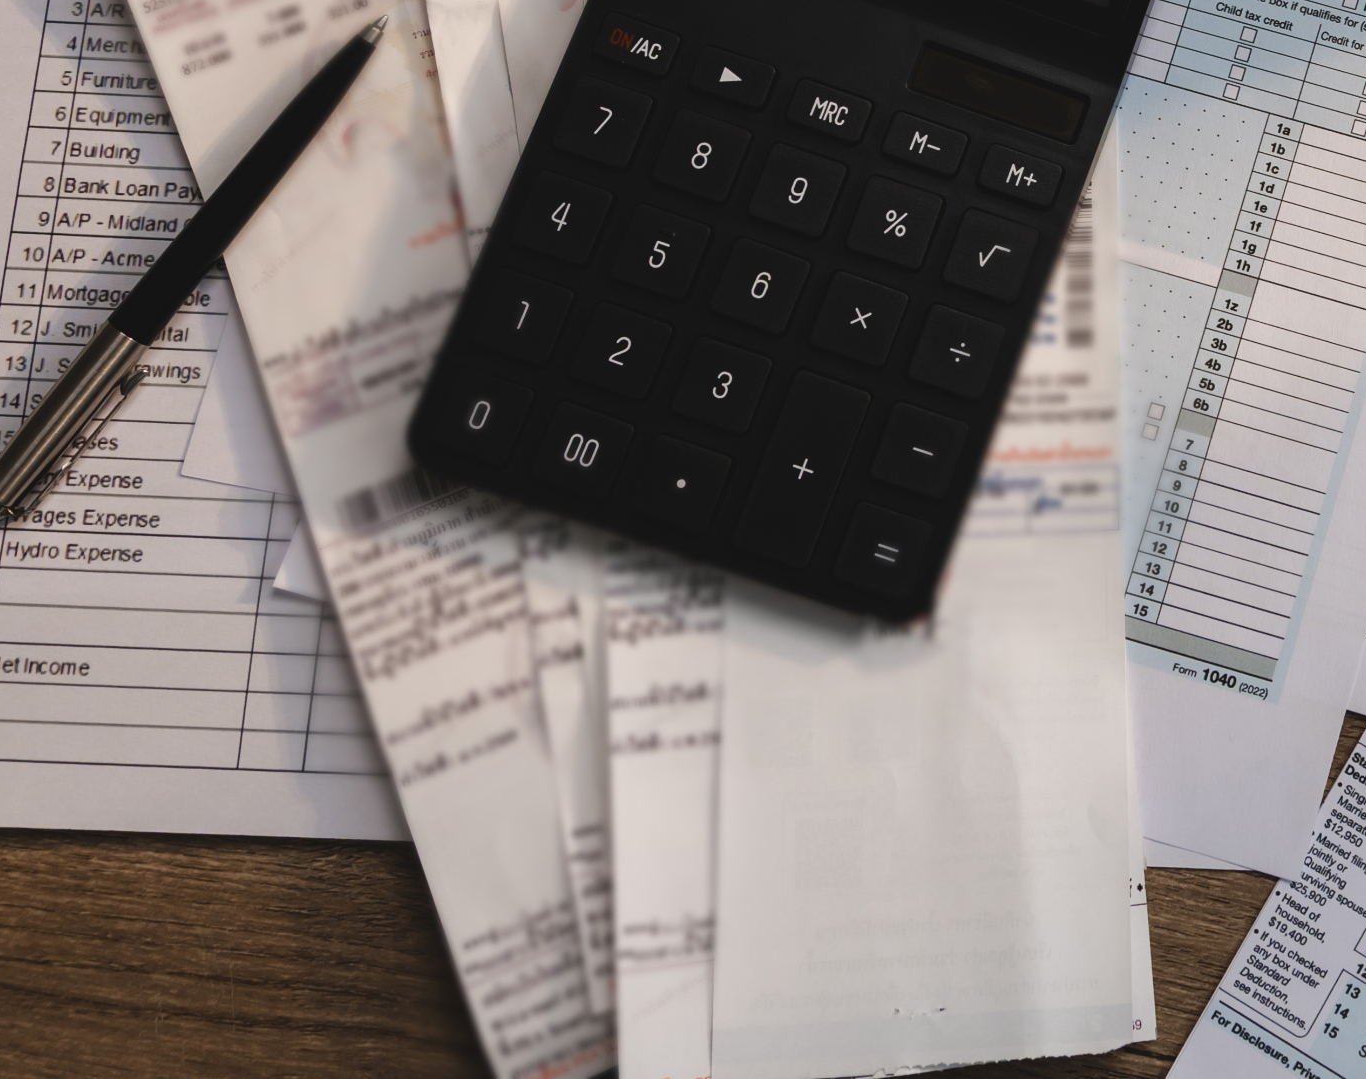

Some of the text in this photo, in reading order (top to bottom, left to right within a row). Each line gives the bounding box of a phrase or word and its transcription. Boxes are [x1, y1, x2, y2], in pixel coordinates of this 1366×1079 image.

[1215, 1, 1294, 32] Child tax credit
[610, 28, 662, 60] ON/AC
[61, 70, 73, 86] 5
[81, 70, 157, 92] Furniture
[593, 106, 613, 135] 7
[809, 96, 849, 126] MRC
[1277, 123, 1291, 136] 1a
[51, 140, 62, 156] 7
[69, 141, 141, 165] Building
[691, 141, 713, 170] 8
[1005, 163, 1038, 187] M+
[788, 177, 808, 204] 9
[551, 202, 571, 232] 4
[883, 209, 908, 238] %
[648, 240, 671, 269] 5
[750, 271, 772, 299] 6
[516, 300, 530, 330] 1
[608, 336, 632, 366] 2
[712, 371, 733, 399] 3
[468, 400, 491, 430] 0
[563, 433, 600, 468] 00
[1164, 499, 1180, 514] 10
[5, 541, 144, 564] Hydro Expense
[1133, 603, 1149, 617] 15
[23, 658, 91, 677] Income
[1172, 662, 1269, 701] Form 1040 (2022)
[1323, 818, 1364, 848] $12,950
